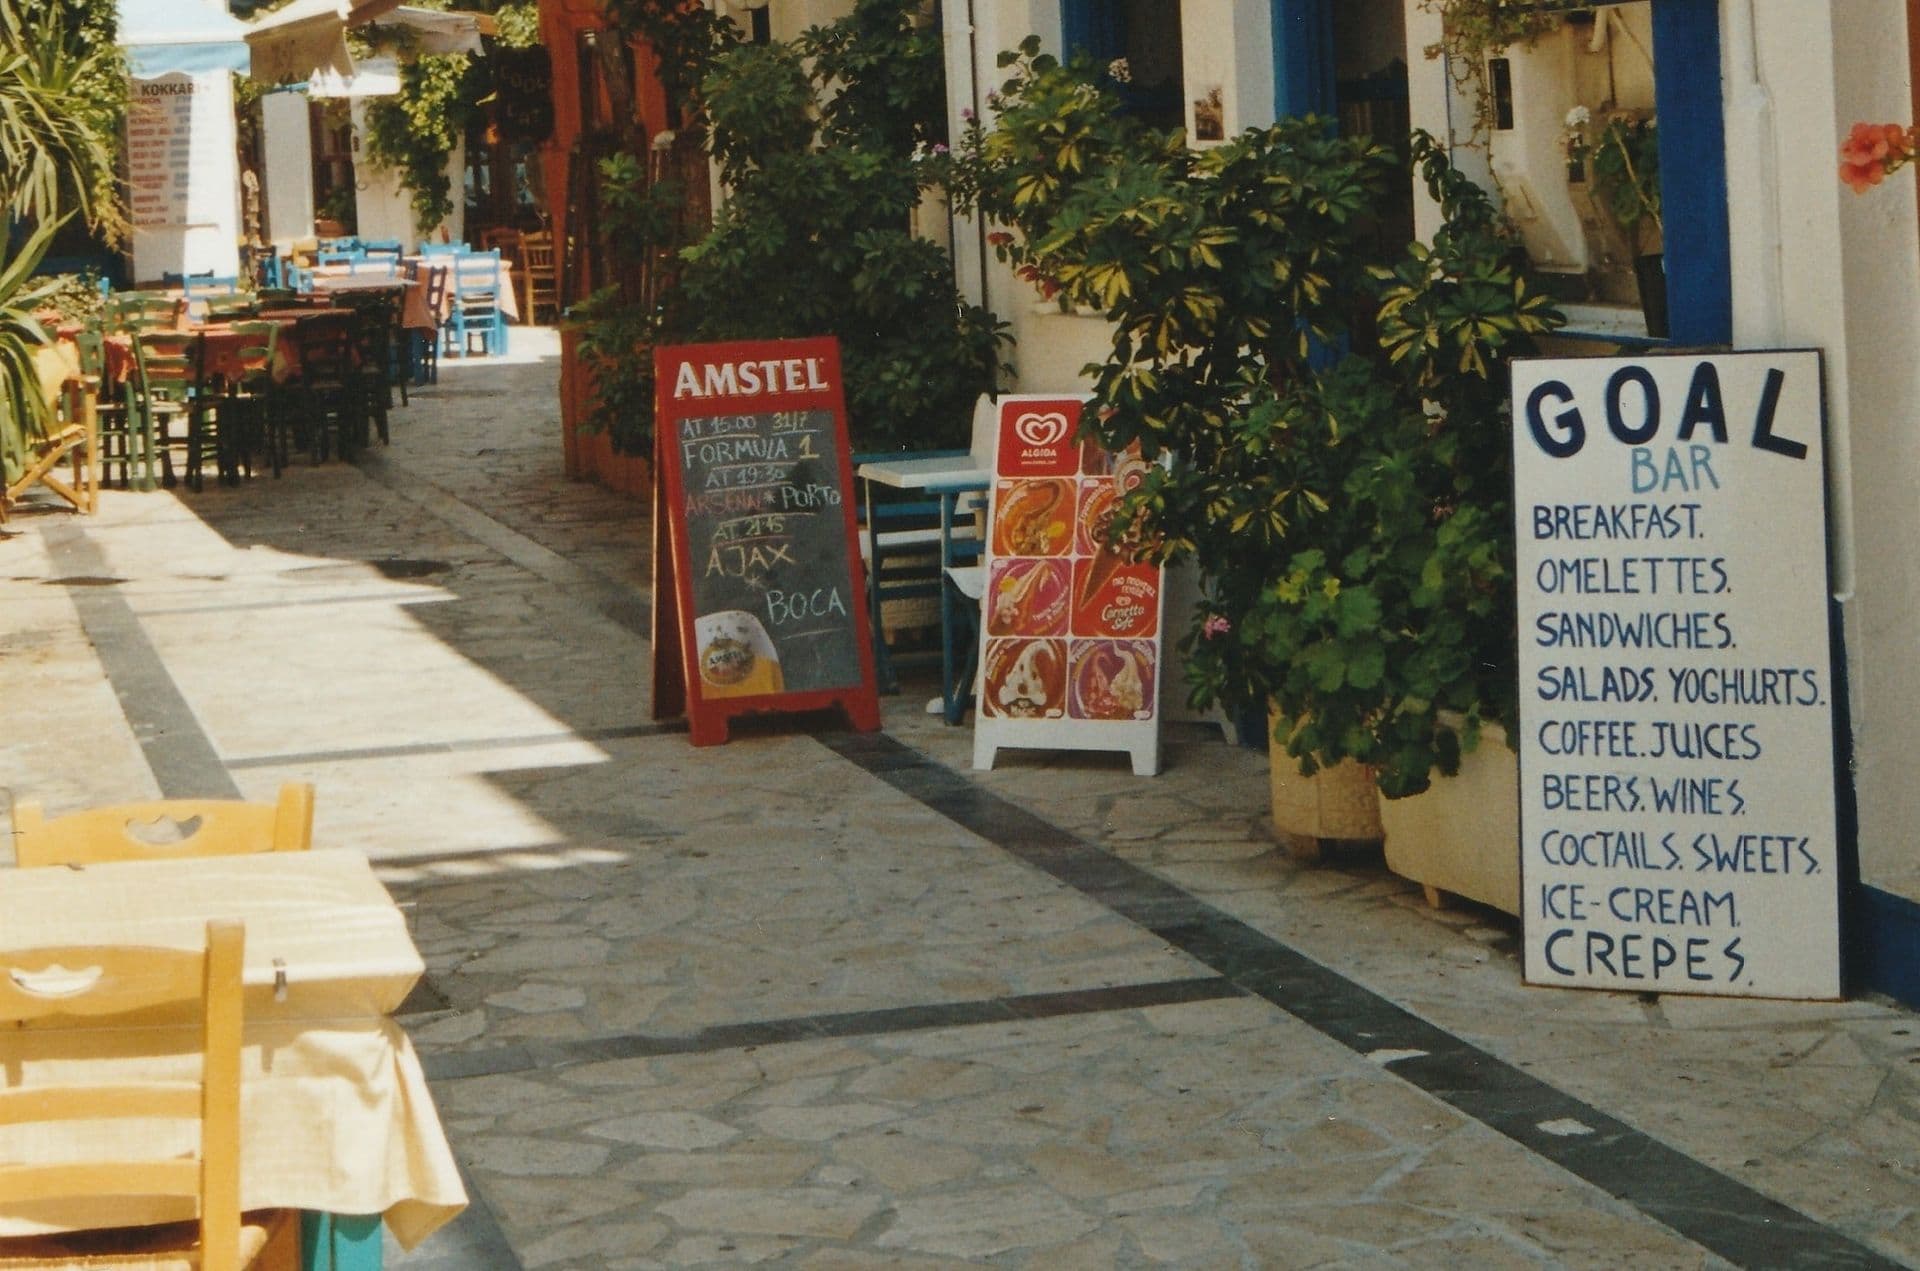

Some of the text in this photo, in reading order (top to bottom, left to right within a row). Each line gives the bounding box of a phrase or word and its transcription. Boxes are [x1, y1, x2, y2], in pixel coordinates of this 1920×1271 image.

[674, 358, 829, 400] AMSTEL
[683, 418, 703, 438] AT
[1525, 361, 1808, 459] GOAL
[683, 434, 820, 469] FORMULA 1
[1021, 448, 1057, 457] ALGIDA
[1631, 445, 1720, 493] BAR
[706, 470, 732, 487] AT
[712, 523, 738, 542] AT
[1533, 503, 1704, 540] BREAKFAST.
[706, 544, 795, 577] AJAX
[1536, 557, 1731, 594] OMELETTES.
[767, 586, 846, 625] BOCA
[1535, 611, 1736, 649] SANDWICHES.
[1537, 665, 1826, 706] SALADS. YOGHURTS.
[1541, 830, 1822, 875] COCTAILS. SWEETS.
[1544, 928, 1754, 987] CREPES.
